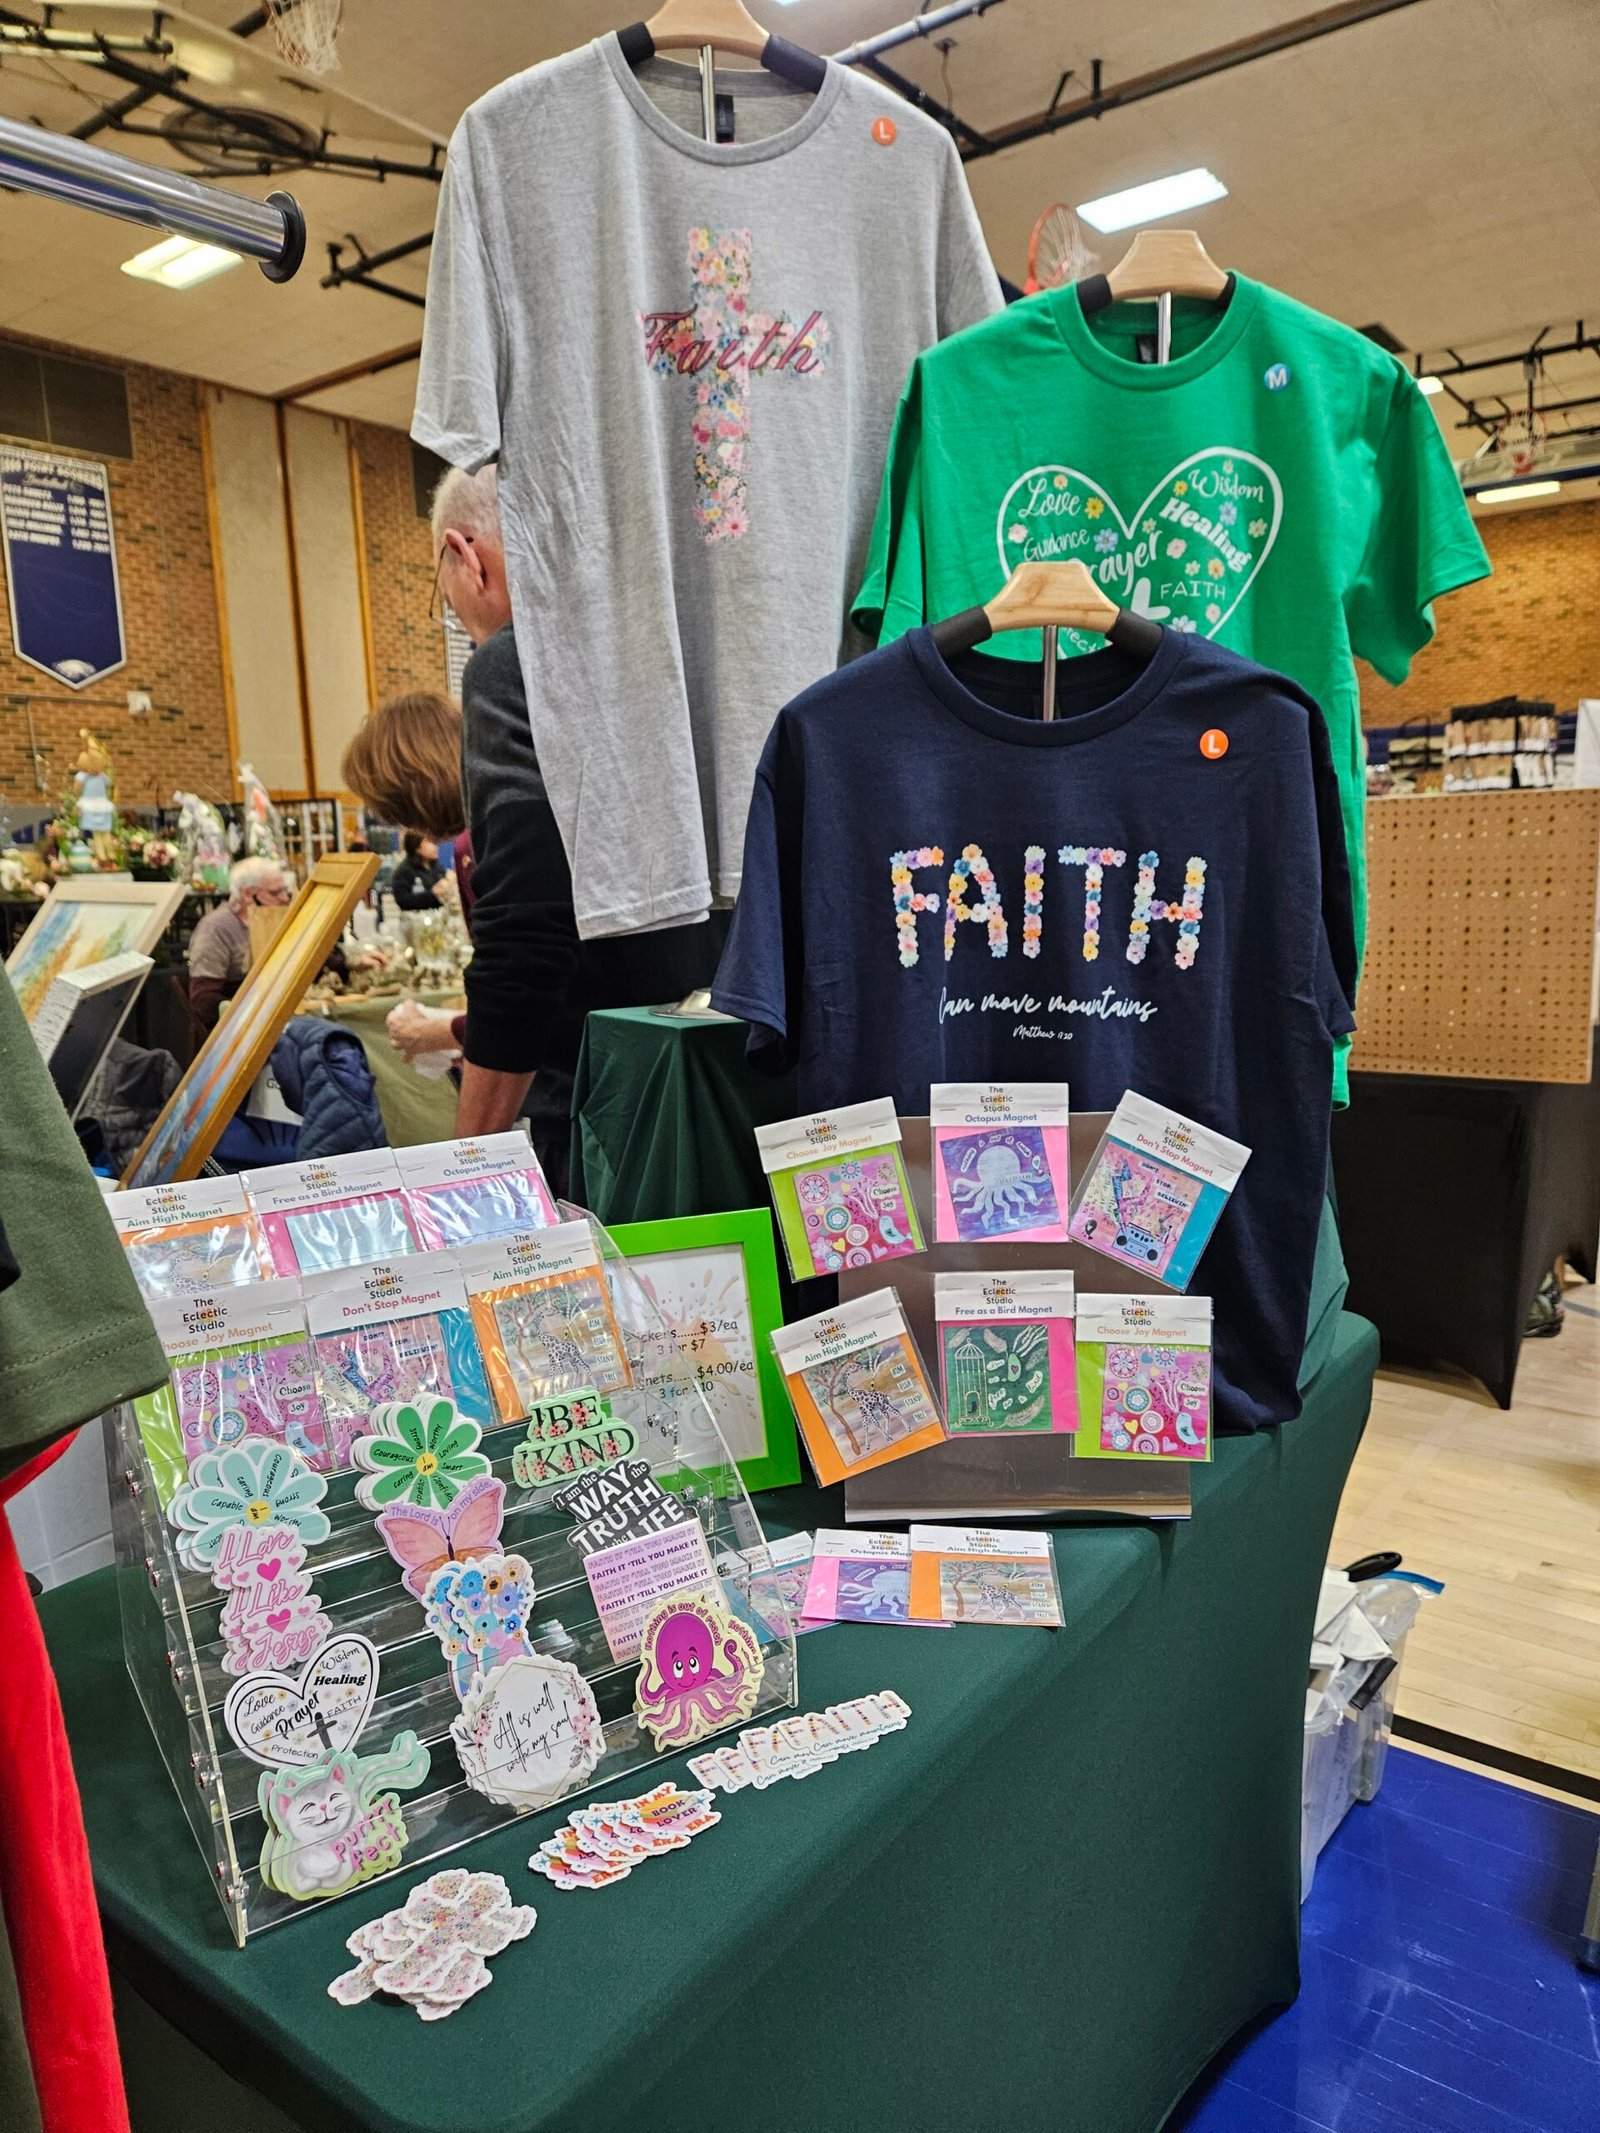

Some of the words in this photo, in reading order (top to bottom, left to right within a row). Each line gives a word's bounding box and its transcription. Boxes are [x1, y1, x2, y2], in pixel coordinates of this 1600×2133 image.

[879, 122, 890, 139] L
[643, 304, 823, 374] Faith
[1268, 370, 1287, 389] M
[1188, 469, 1264, 503] Wisdom
[1018, 478, 1081, 517] Love
[1160, 497, 1252, 573] Healing
[1023, 528, 1090, 562] Guidance
[1086, 530, 1162, 596] rayer
[1160, 580, 1226, 600] FAITH
[1208, 735, 1220, 753] L
[890, 844, 1207, 970] FAITH
[980, 993, 1041, 1014] move
[1048, 985, 1158, 1022] mountains
[1012, 1024, 1055, 1040] Matthew
[980, 1095, 1013, 1103] Eclectic
[983, 1105, 1010, 1113] Studio
[812, 1116, 827, 1125] The
[965, 1114, 1001, 1124] Octopus
[1003, 1114, 1037, 1123] Magnet
[1178, 1122, 1192, 1134] The
[805, 1123, 838, 1137] Eclectic
[1164, 1126, 1197, 1147] Eclectic
[786, 1148, 819, 1161] Choose
[822, 1143, 838, 1154] Joy
[838, 1135, 873, 1150] Magnet
[810, 1134, 837, 1145] Studio
[1162, 1136, 1189, 1154] Studio
[1136, 1133, 1160, 1151] Don't
[1160, 1145, 1180, 1161] Stop
[1181, 1155, 1214, 1177] Magnet
[300, 1170, 338, 1182] Eclectic
[308, 1163, 325, 1171] The
[443, 1165, 480, 1177] Octopus
[482, 1159, 516, 1171] Magnet
[155, 1186, 174, 1194] The
[273, 1196, 297, 1205] Free
[321, 1187, 342, 1197] Bird
[343, 1181, 382, 1195] Magnet
[305, 1180, 336, 1190] Studio
[146, 1194, 187, 1206] Eclectic
[127, 1217, 150, 1228] Aim
[152, 1213, 179, 1225] High
[180, 1207, 223, 1222] Magnet
[151, 1204, 185, 1215] Studio
[514, 1234, 530, 1242] The
[506, 1242, 542, 1255] Eclectic
[512, 1253, 541, 1265] Studio
[372, 1266, 391, 1276] The
[492, 1270, 512, 1281] Aim
[513, 1265, 536, 1276] High
[537, 1257, 573, 1270] Magnet
[364, 1275, 404, 1289] Eclectic
[369, 1286, 402, 1300] Studio
[194, 1298, 213, 1308] The
[342, 1303, 372, 1317] Don't
[374, 1299, 399, 1312] Stop
[401, 1290, 441, 1306] Magnet
[955, 1307, 976, 1315] Free
[997, 1305, 1017, 1314] Bird
[1018, 1305, 1053, 1316] Magnet
[183, 1307, 228, 1323] Eclectic
[819, 1316, 835, 1326] The
[188, 1320, 225, 1334] Studio
[204, 1331, 224, 1344] Joy
[227, 1322, 273, 1339] Magnet
[813, 1321, 847, 1339] Eclectic
[1097, 1327, 1133, 1336] Choose
[1135, 1327, 1150, 1337] Joy
[1151, 1328, 1187, 1338] Magnet
[657, 1345, 664, 1355] 3
[691, 1339, 705, 1352] $7
[804, 1353, 822, 1364] Aim
[823, 1344, 844, 1358] High
[845, 1331, 878, 1348] Magnet
[820, 1332, 847, 1347] Studio
[279, 1383, 311, 1396] Choose
[660, 1389, 666, 1398] 3
[669, 1386, 688, 1398] for
[546, 1396, 603, 1436] BE
[410, 1428, 423, 1450] Strong
[430, 1424, 443, 1449] Worthy
[373, 1449, 414, 1463] Courageous
[439, 1440, 459, 1458] Loving
[531, 1428, 635, 1480] KIND
[441, 1462, 463, 1470] Smart
[263, 1453, 282, 1498] Courageous
[566, 1487, 581, 1501] am
[581, 1473, 598, 1489] the
[569, 1464, 631, 1520] WAY
[631, 1464, 647, 1478] the
[211, 1499, 244, 1511] Capable
[275, 1492, 300, 1507] Strong
[391, 1507, 407, 1516] The
[411, 1509, 431, 1521] Lord
[431, 1516, 439, 1526] is
[451, 1507, 461, 1520] on
[461, 1494, 473, 1512] my
[572, 1478, 661, 1555] TRUTH
[592, 1567, 616, 1581] FAITH
[628, 1558, 646, 1568] 'TILL
[648, 1550, 665, 1561] YOU
[667, 1543, 689, 1555] MAKE
[601, 1598, 626, 1612] FAITH
[627, 1594, 635, 1602] IT
[637, 1587, 656, 1598] 'TILL
[658, 1581, 675, 1591] YOU
[676, 1572, 699, 1584] MAKE
[701, 1568, 708, 1576] IT
[645, 1609, 669, 1651] Nothing
[668, 1604, 677, 1613] is
[678, 1603, 695, 1611] out
[696, 1607, 708, 1617] of
[705, 1615, 723, 1646] reach
[253, 1626, 319, 1668] Jesus
[320, 1647, 360, 1670] Wisdom
[313, 1674, 367, 1686] Healing
[244, 1694, 276, 1717] Love
[327, 1696, 362, 1718] FAITH
[251, 1705, 286, 1735] Guidance
[275, 1691, 320, 1739] Prayer
[494, 1711, 517, 1749] All
[519, 1712, 531, 1727] is
[533, 1681, 555, 1716] well
[783, 1693, 907, 1745] FAITH
[507, 1739, 530, 1773] with
[532, 1732, 551, 1758] my
[551, 1700, 575, 1738] soul
[813, 1741, 833, 1752] Can
[835, 1735, 857, 1747] move
[859, 1721, 903, 1737] mountains
[271, 1744, 318, 1760] Protection
[634, 1797, 647, 1809] IN
[652, 1786, 672, 1800] MY
[652, 1799, 685, 1816] BOOK
[657, 1807, 697, 1827] LOVER
[686, 1815, 715, 1831] ERA
